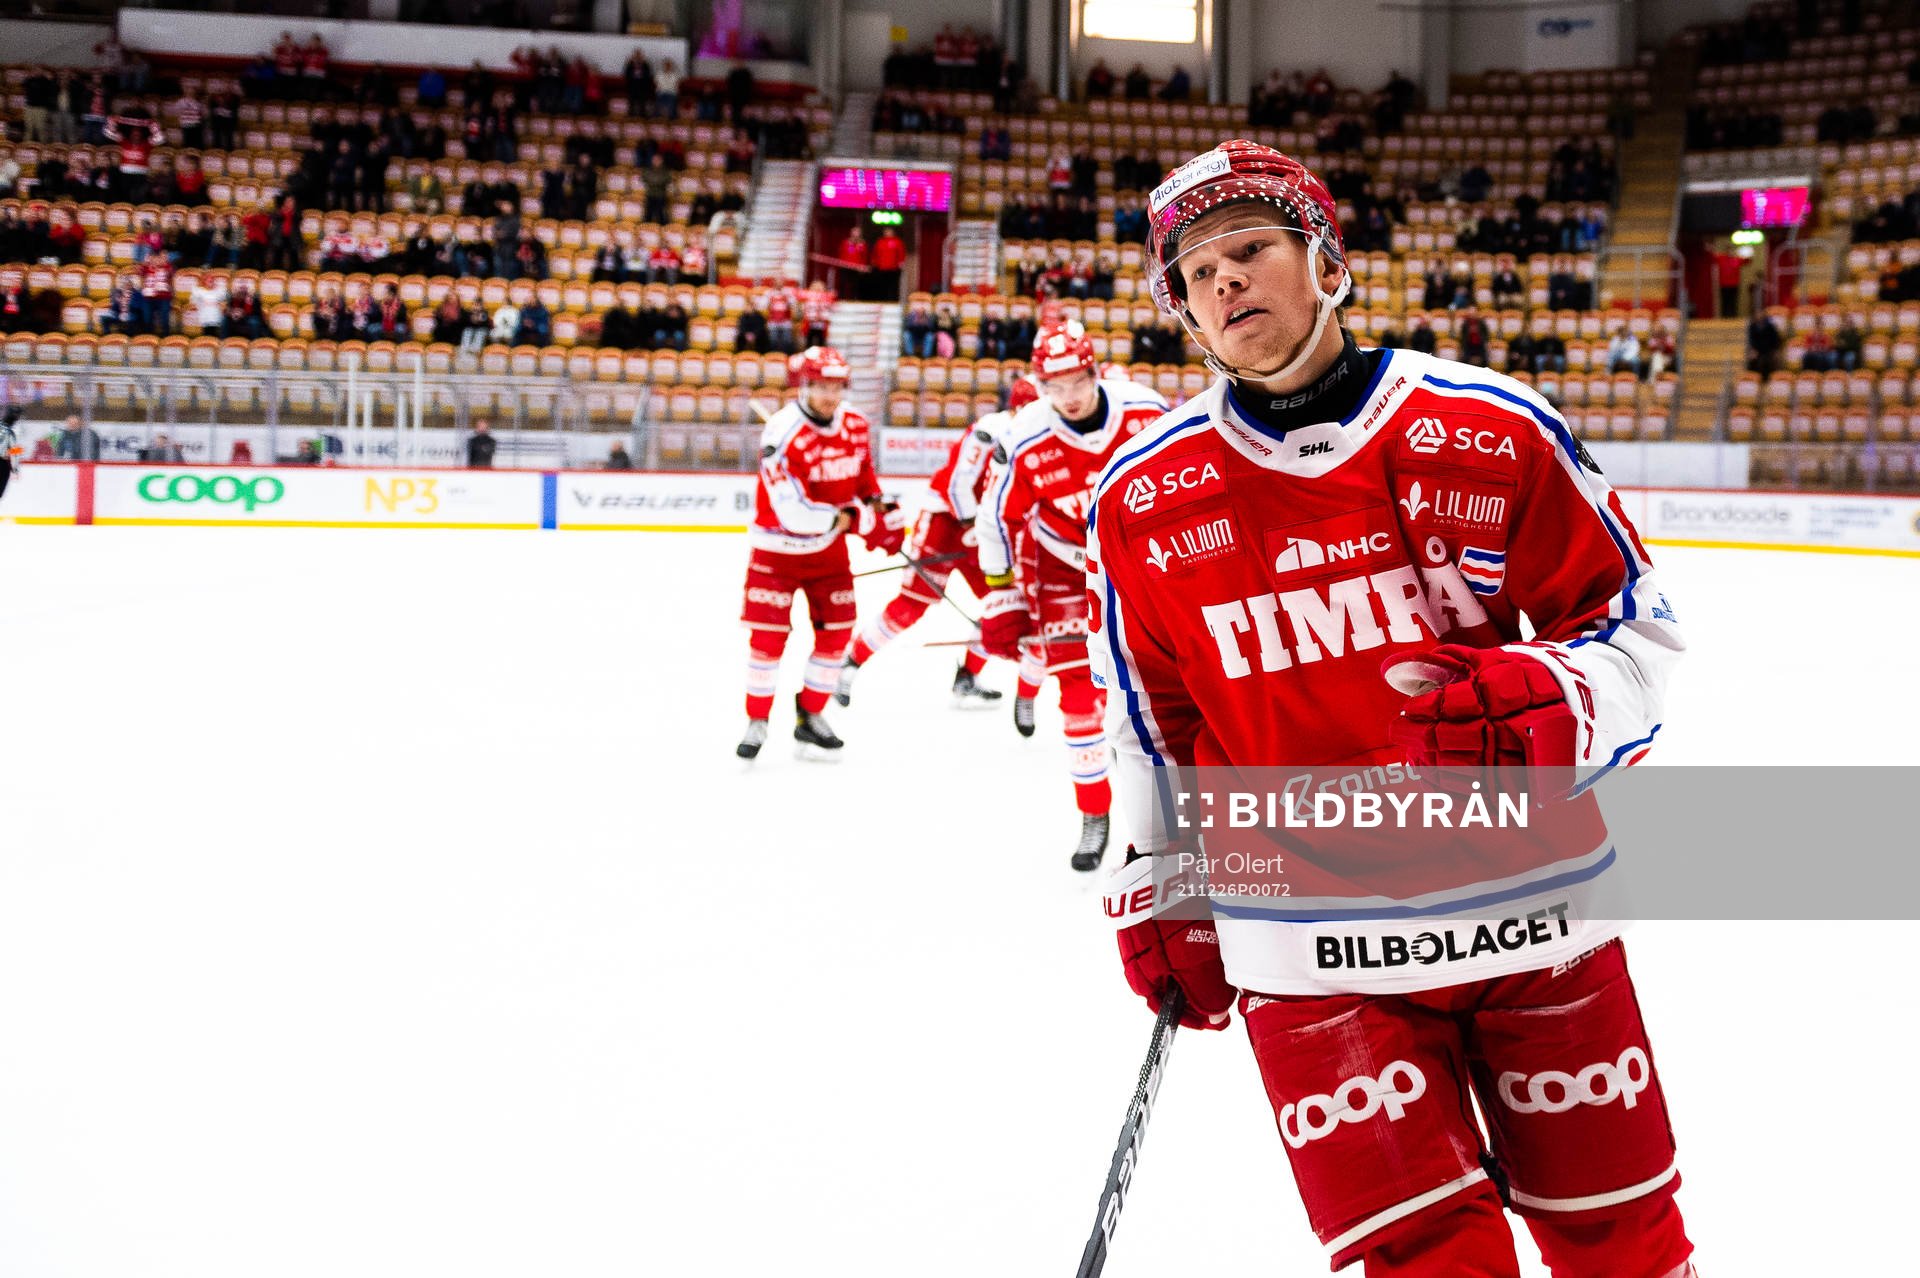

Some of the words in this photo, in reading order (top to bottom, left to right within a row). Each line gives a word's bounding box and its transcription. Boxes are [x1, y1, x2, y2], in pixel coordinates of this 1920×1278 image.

[1299, 441, 1336, 457] SHL
[1453, 427, 1517, 460] SCA
[137, 474, 285, 512] coop
[365, 476, 439, 513] NP3
[1162, 462, 1220, 495] SCA
[1435, 489, 1506, 524] LILIUM
[1169, 518, 1234, 559] LILIUM
[1181, 545, 1237, 565] FASTIGHETER
[1326, 532, 1392, 562] NHC
[1201, 535, 1489, 680] TIMRÅ
[1316, 901, 1570, 969] BILBOLAGET
[1498, 1046, 1650, 1114] coop
[1279, 1060, 1427, 1149] coop
